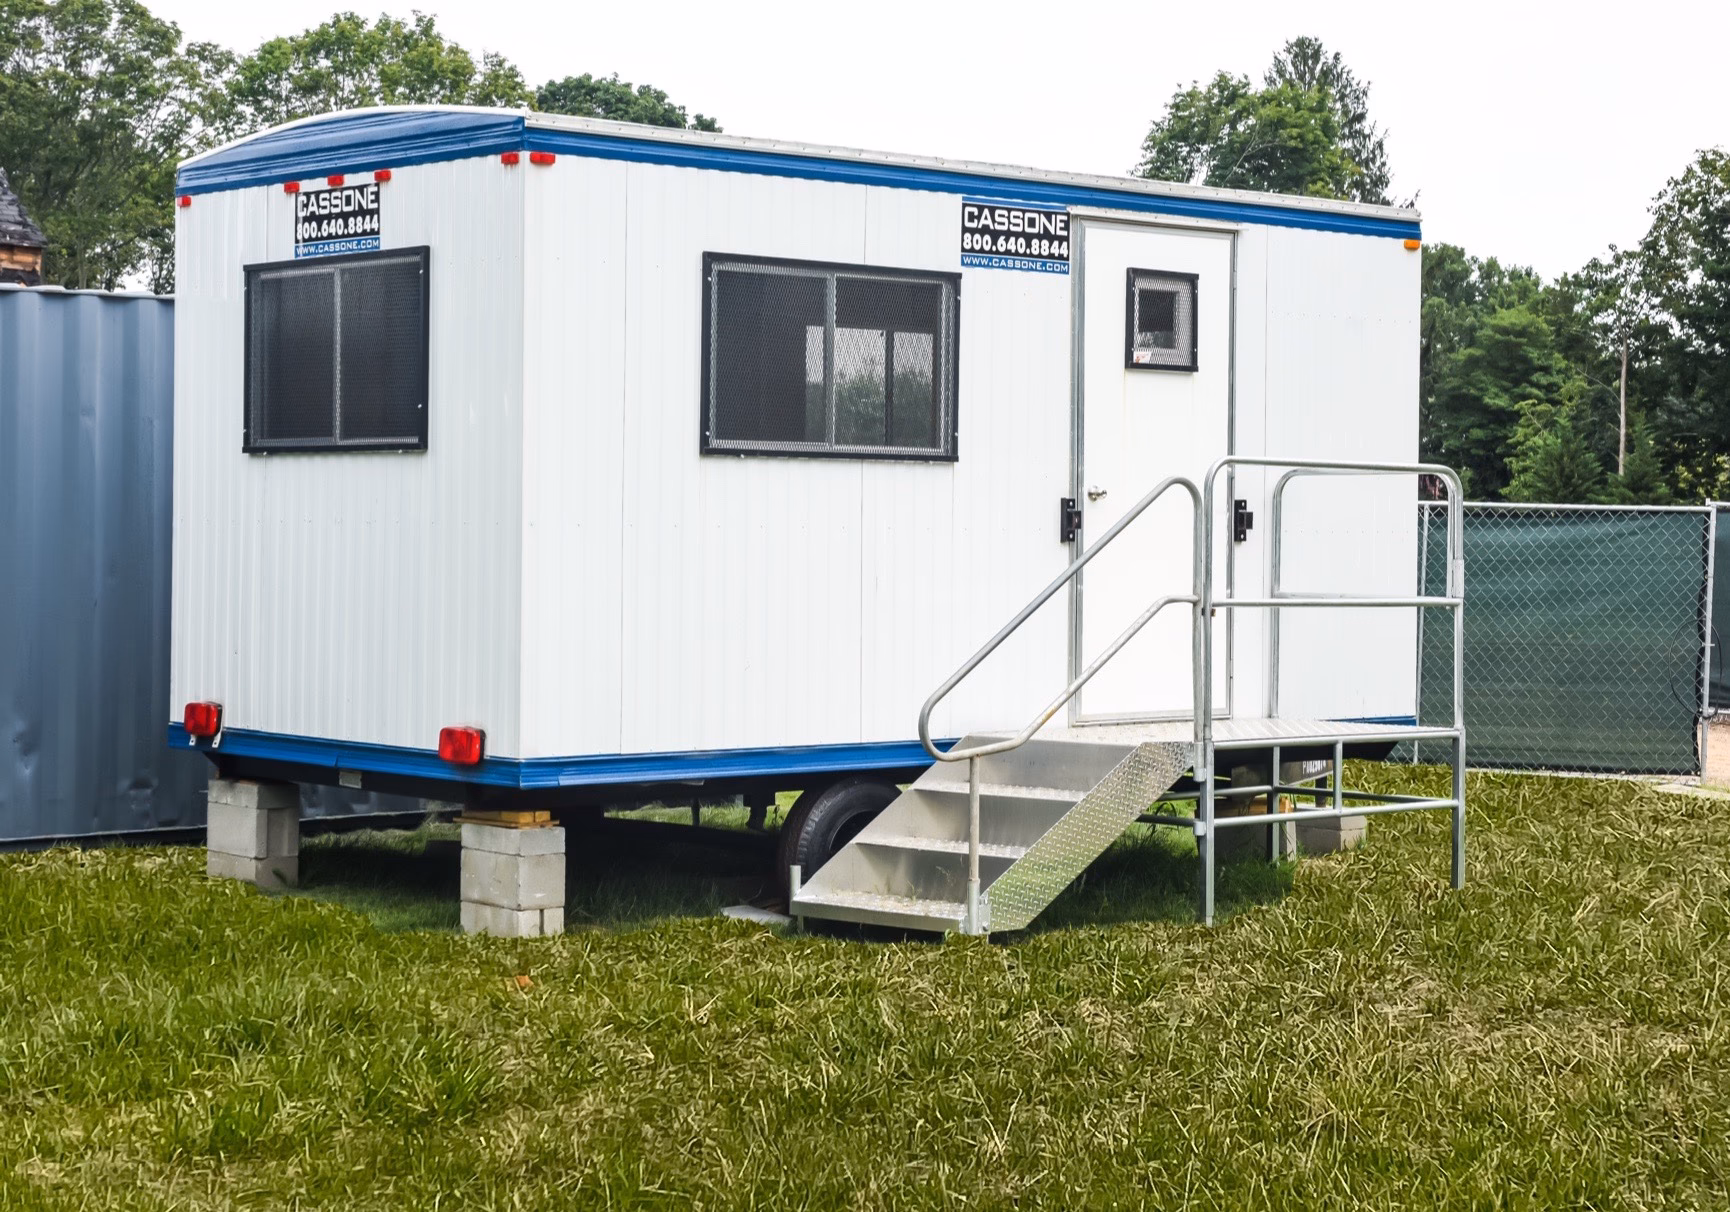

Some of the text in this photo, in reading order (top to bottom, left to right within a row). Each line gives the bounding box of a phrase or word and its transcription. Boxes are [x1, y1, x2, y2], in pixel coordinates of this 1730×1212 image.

[297, 186, 379, 217] CASSONE
[296, 214, 379, 240] 800.640.8844
[964, 206, 1068, 236] CASSONE
[296, 239, 380, 255] WWW.CASSONE.COM
[963, 232, 1069, 258] 800.640.8844
[963, 256, 1069, 273] WWW.CASSONE.COM
